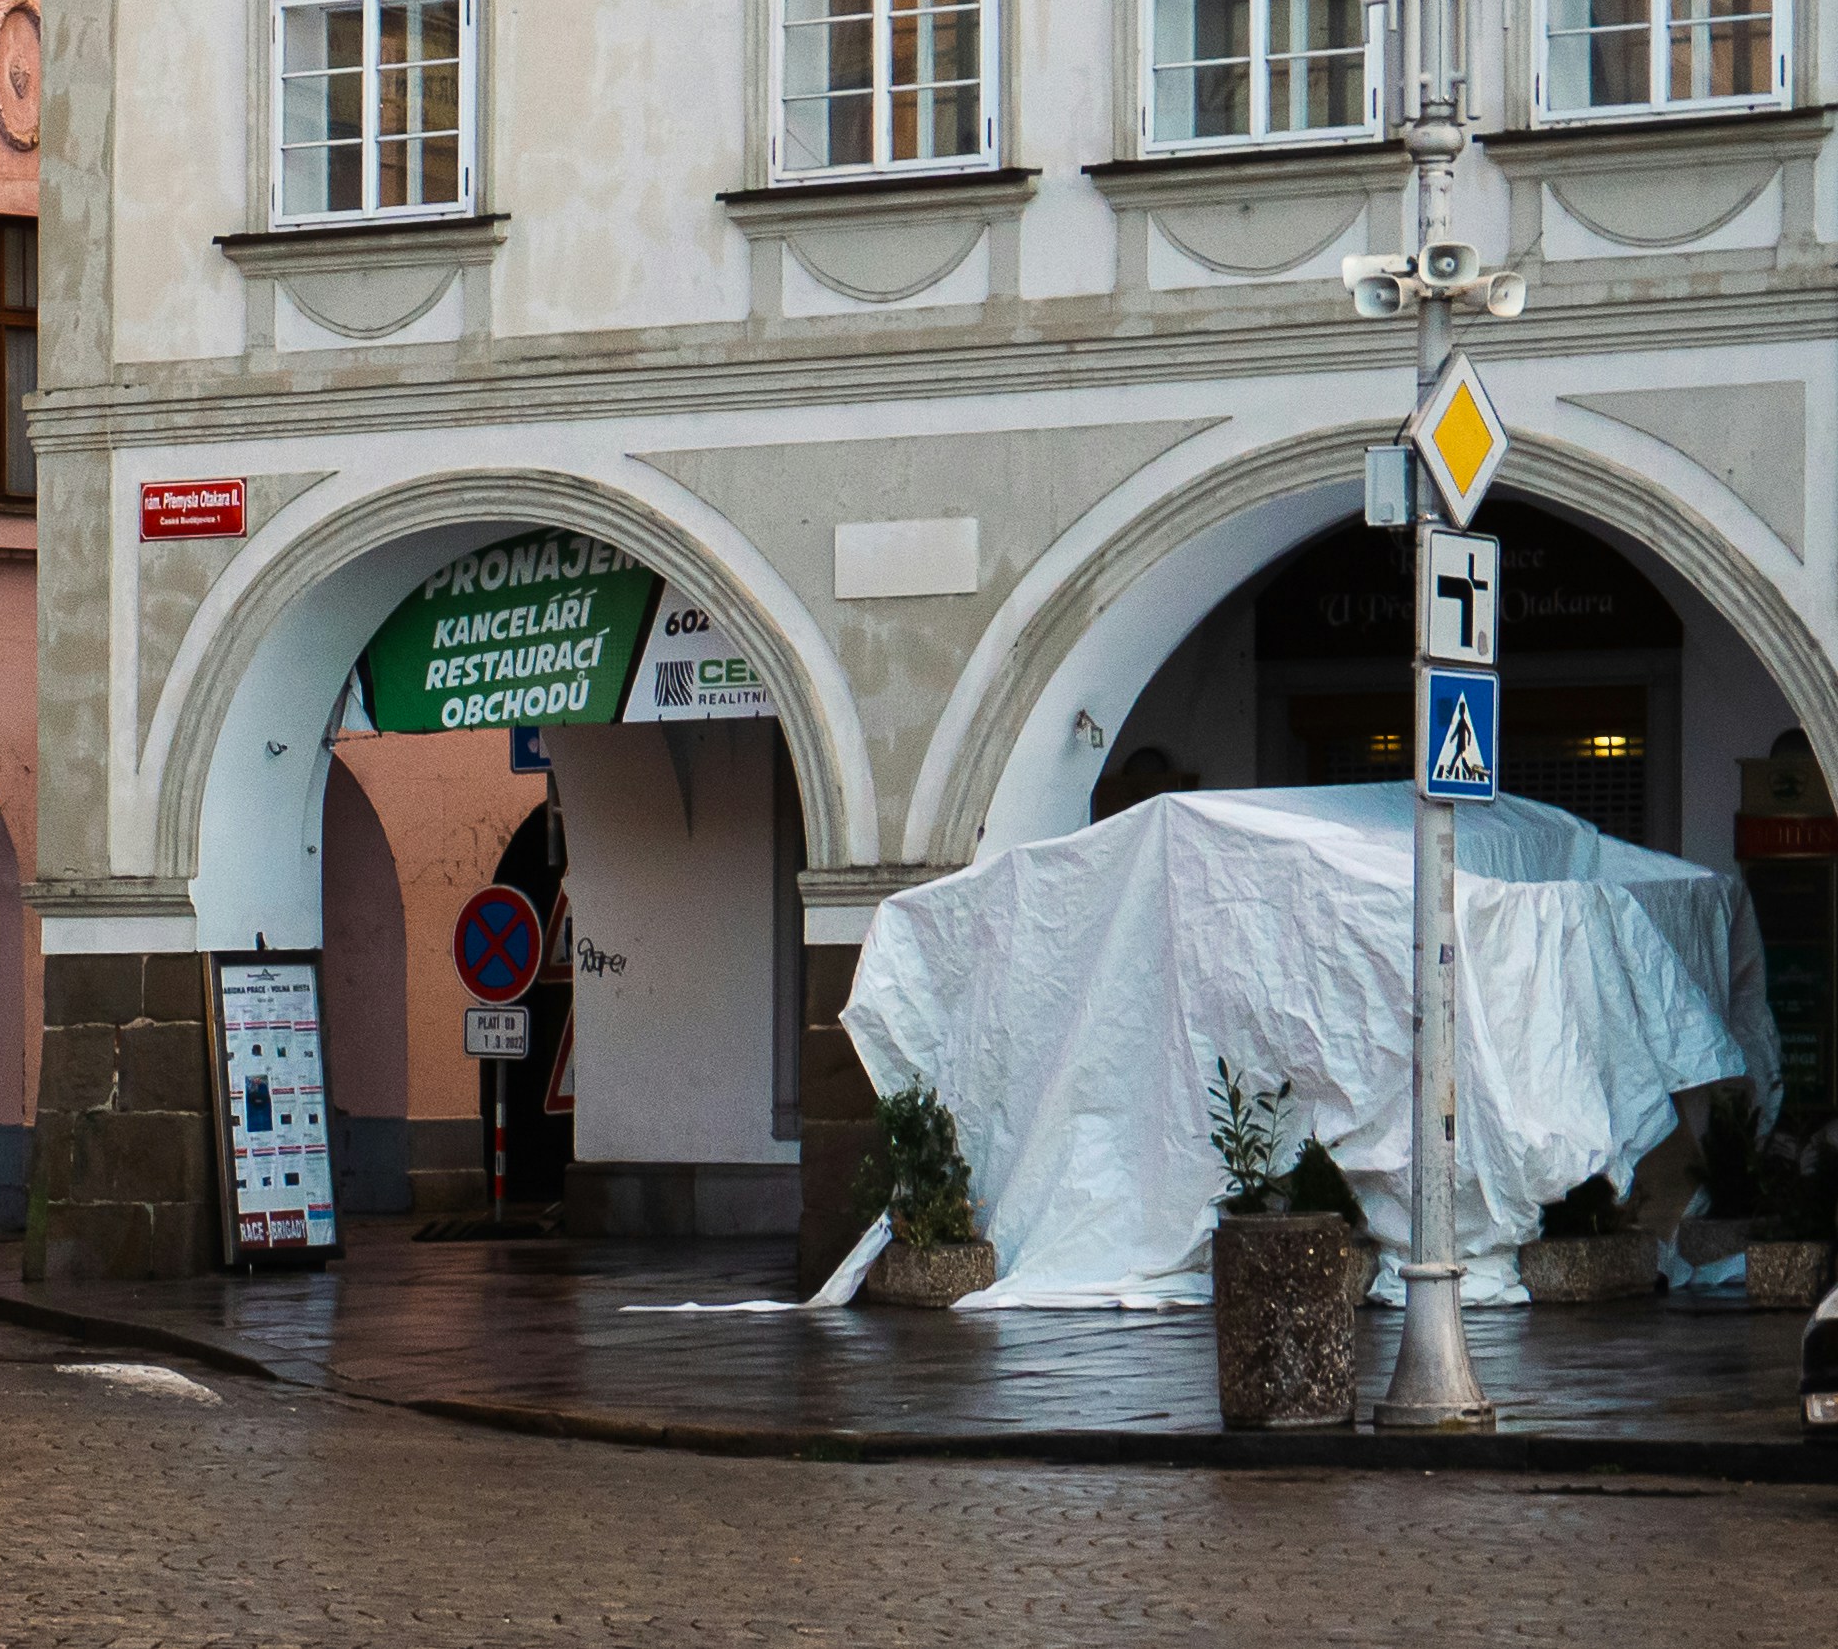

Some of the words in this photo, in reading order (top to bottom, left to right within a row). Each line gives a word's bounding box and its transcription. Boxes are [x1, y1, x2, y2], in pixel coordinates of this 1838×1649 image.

[145, 494, 162, 510] nám.
[163, 492, 198, 513] Přemysla
[200, 490, 230, 508] Otakara
[433, 587, 598, 649] KANCELÁŘÍ
[665, 609, 710, 637] 602
[1501, 587, 1614, 624] Otakara
[425, 627, 610, 690] RESTAURACÍ
[441, 671, 590, 728] OBCHODŮ
